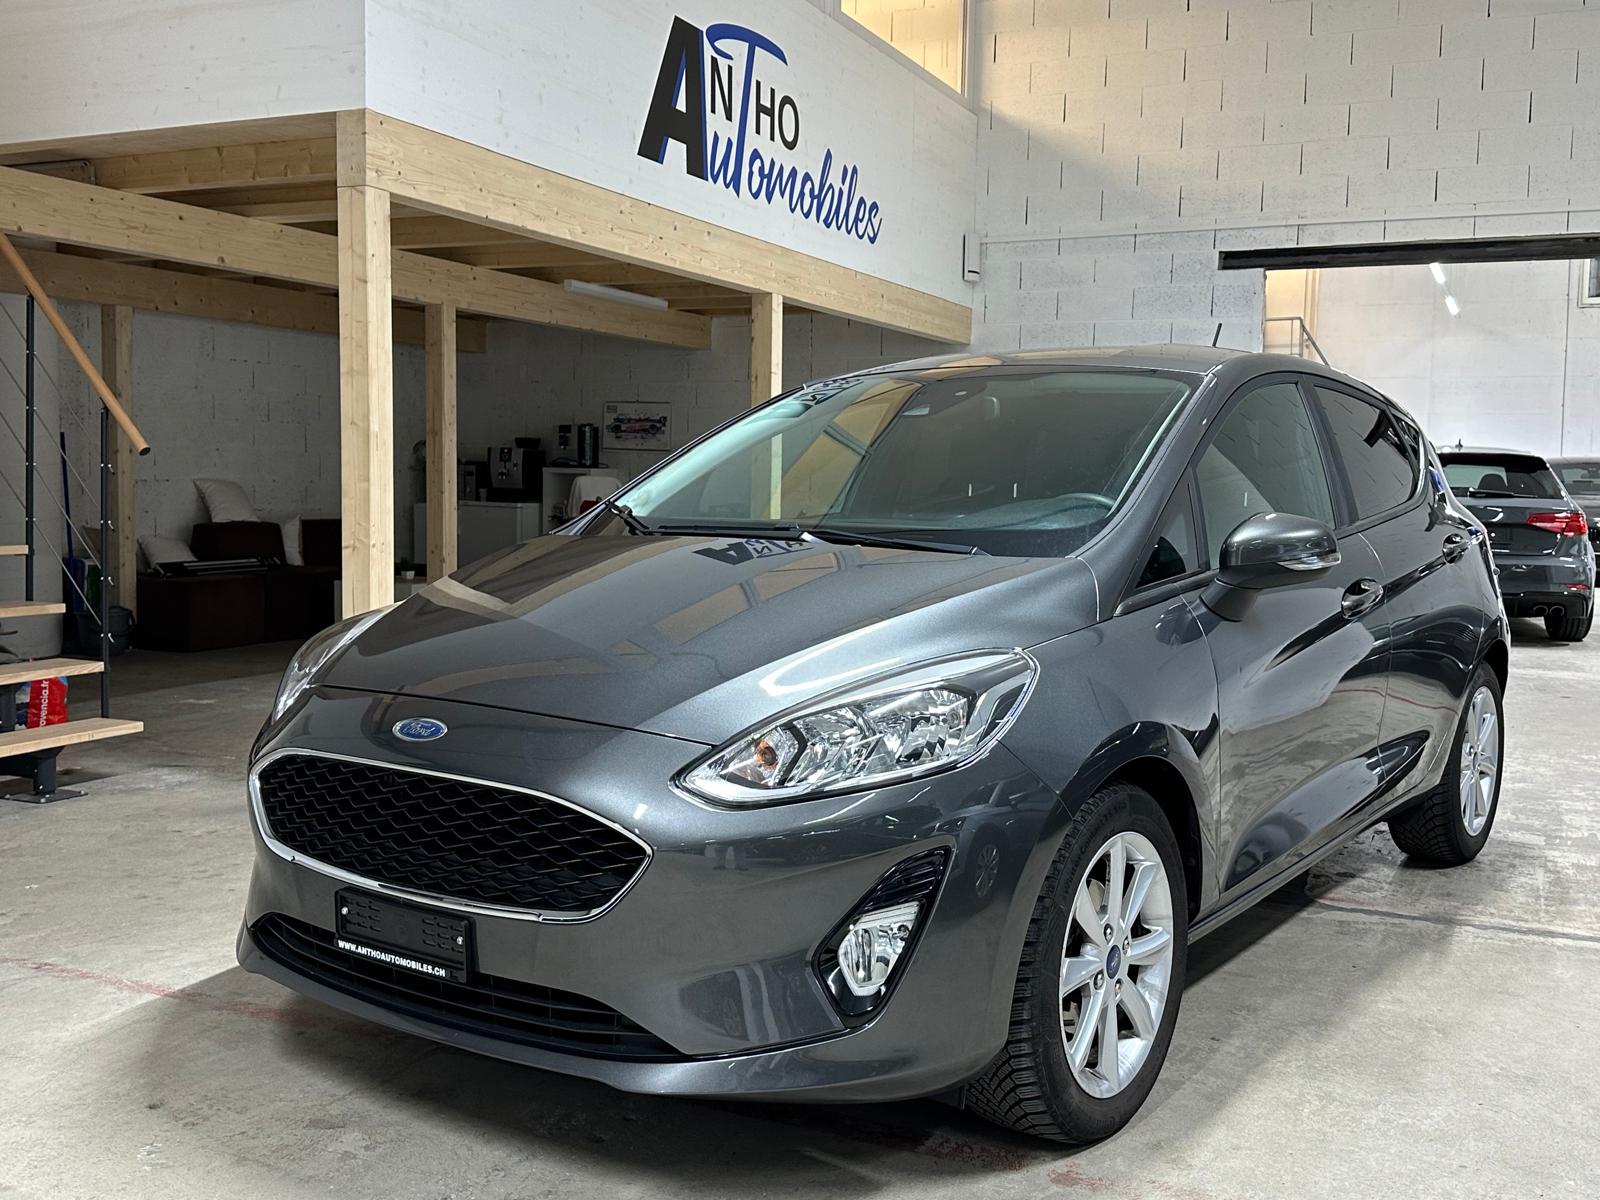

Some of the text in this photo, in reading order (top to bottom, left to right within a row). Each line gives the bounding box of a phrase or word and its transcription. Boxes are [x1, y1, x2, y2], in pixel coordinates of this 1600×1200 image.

[637, 15, 800, 198] ANTHO
[39, 679, 50, 728] ovencia.fr
[402, 721, 436, 737] Ford
[337, 939, 446, 977] WWW.ANTHOAUTOMOBILES.CH
